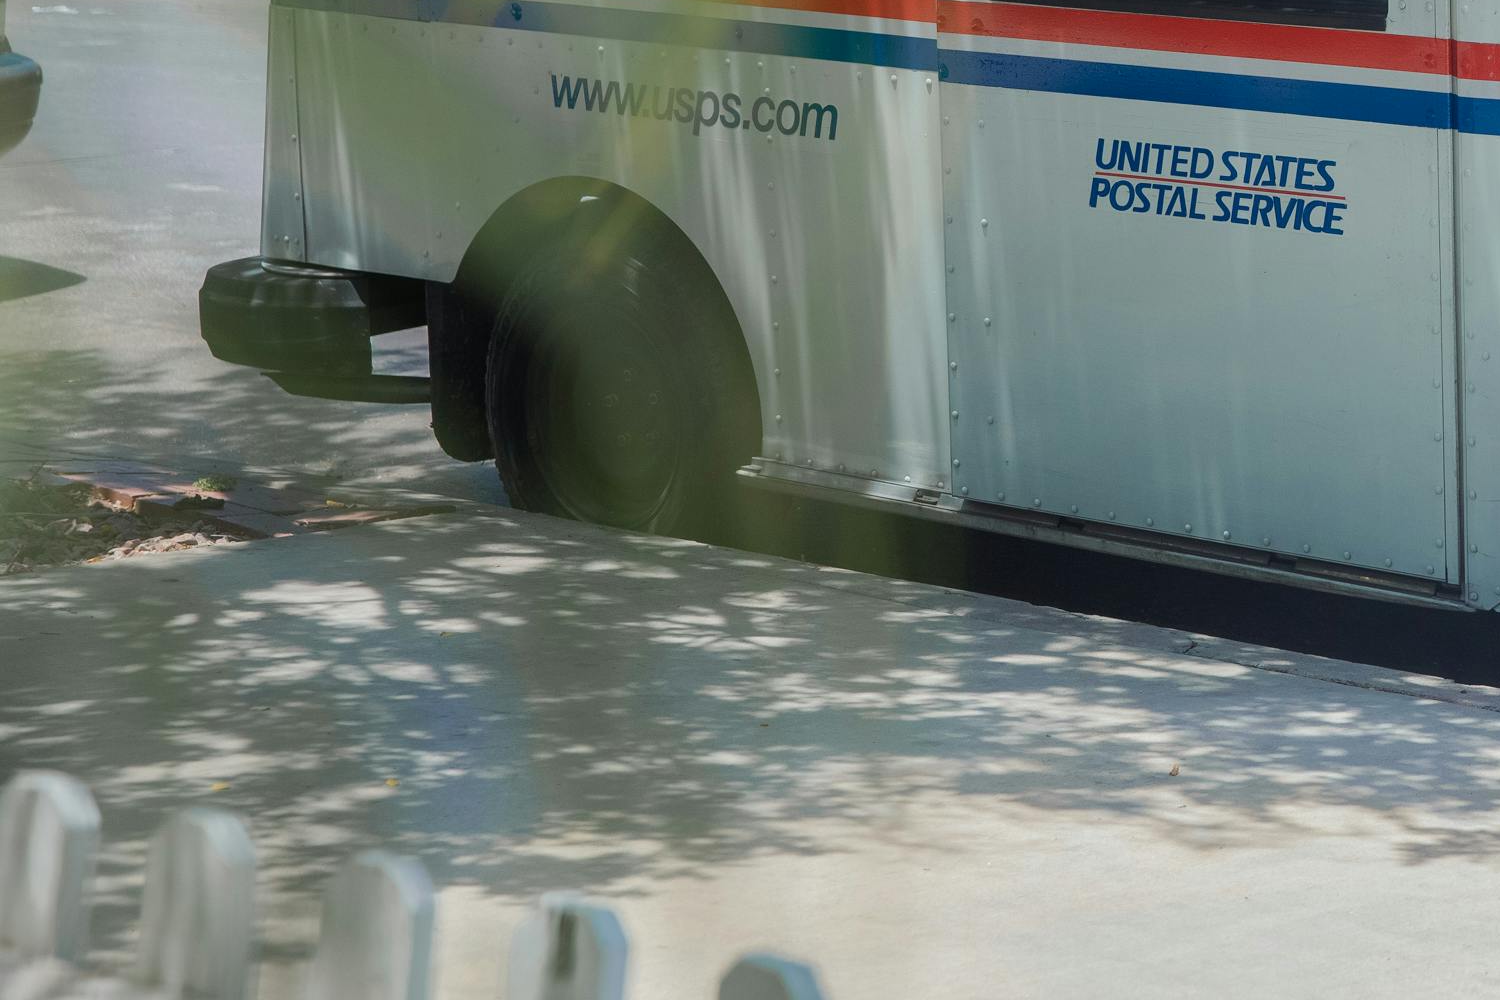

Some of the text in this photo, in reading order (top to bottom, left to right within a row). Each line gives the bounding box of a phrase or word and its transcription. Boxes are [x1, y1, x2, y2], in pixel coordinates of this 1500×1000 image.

[551, 74, 838, 140] www.usps.com
[1095, 138, 1336, 192] UNITED STATES
[1089, 177, 1348, 235] POSTAL SERVICE
